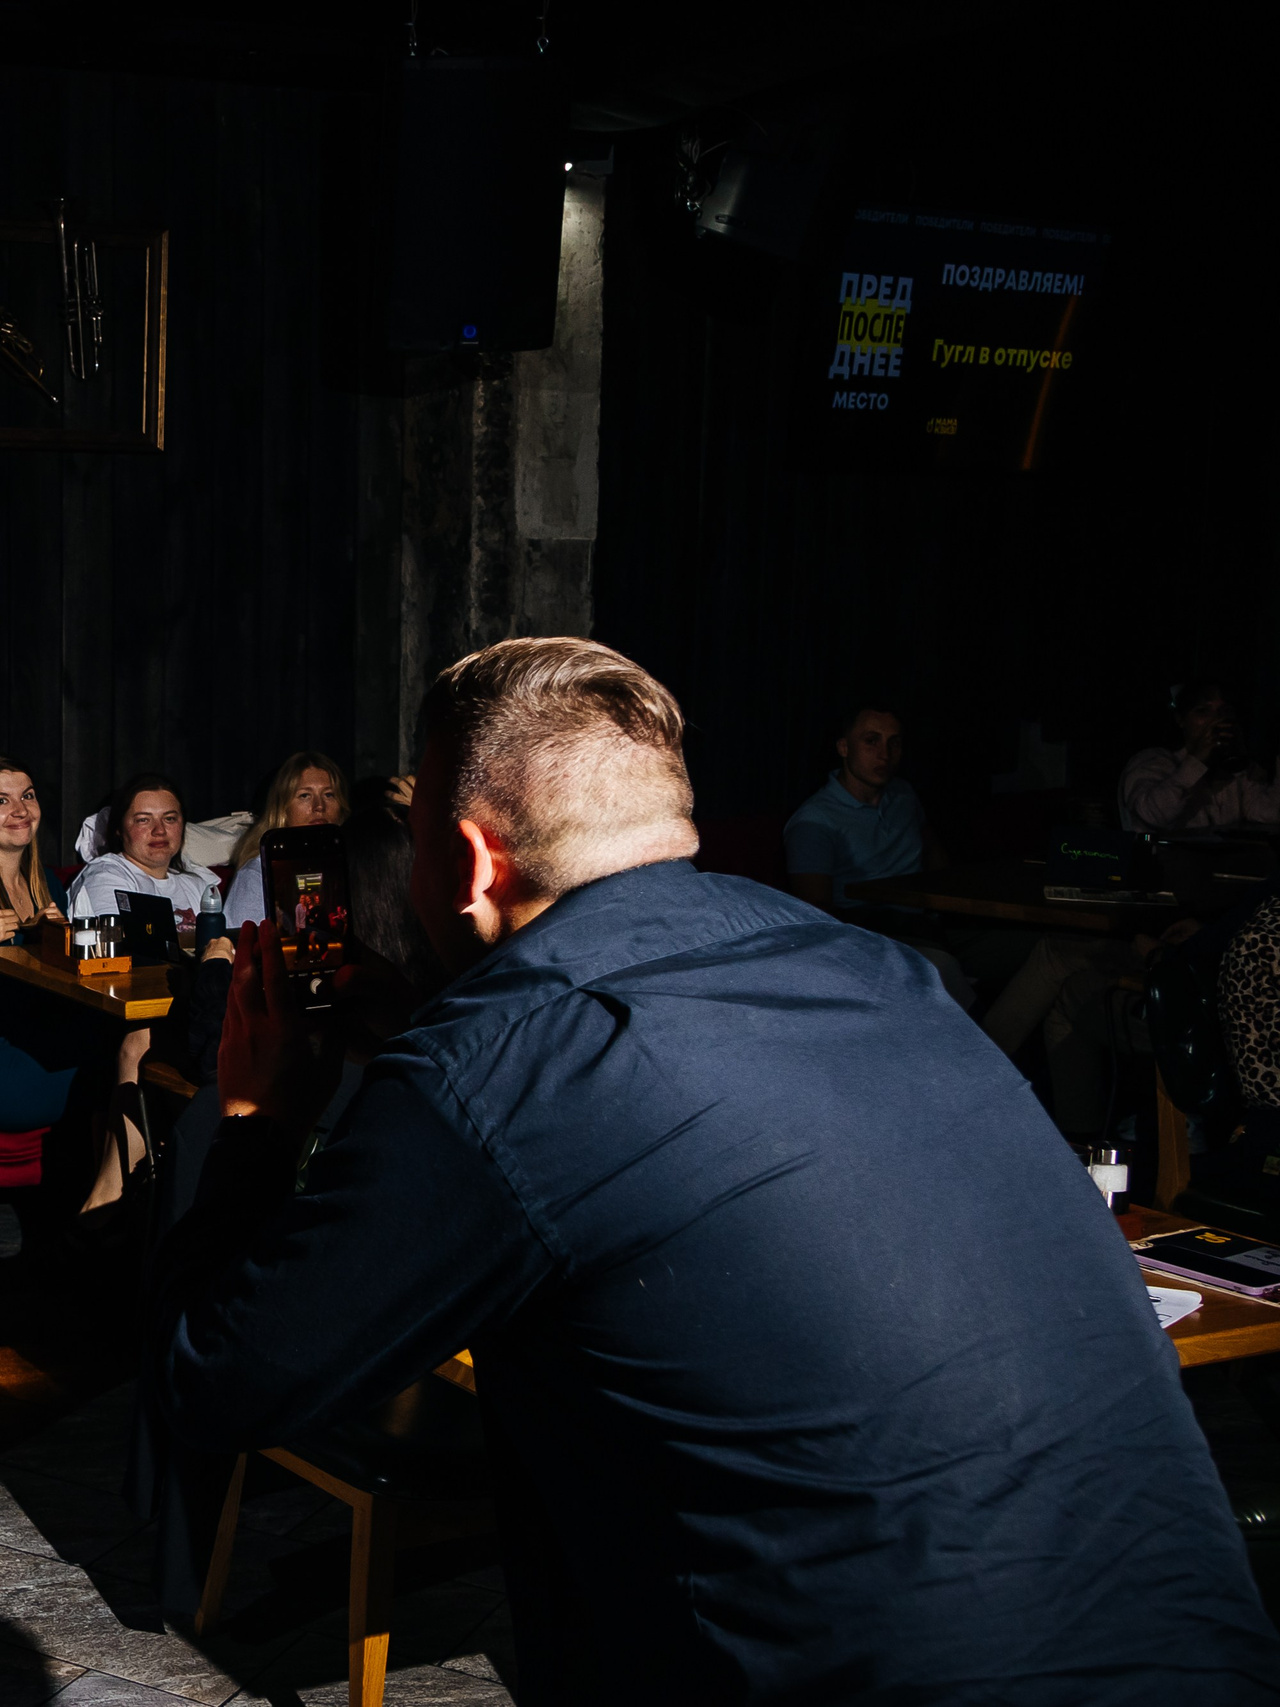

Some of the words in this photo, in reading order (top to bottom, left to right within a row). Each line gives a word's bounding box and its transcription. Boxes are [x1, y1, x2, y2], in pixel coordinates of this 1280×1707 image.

[838, 271, 915, 314] ПРЕД
[941, 263, 1086, 296] ПОЗДРАВЛЯЕМ!
[838, 310, 905, 344] ПОСЛЕ
[827, 343, 904, 380] ДНЕЕ
[931, 338, 976, 369] Гугл
[978, 346, 989, 365] в
[993, 346, 1073, 374] отпуске
[831, 390, 890, 411] МЕСТО
